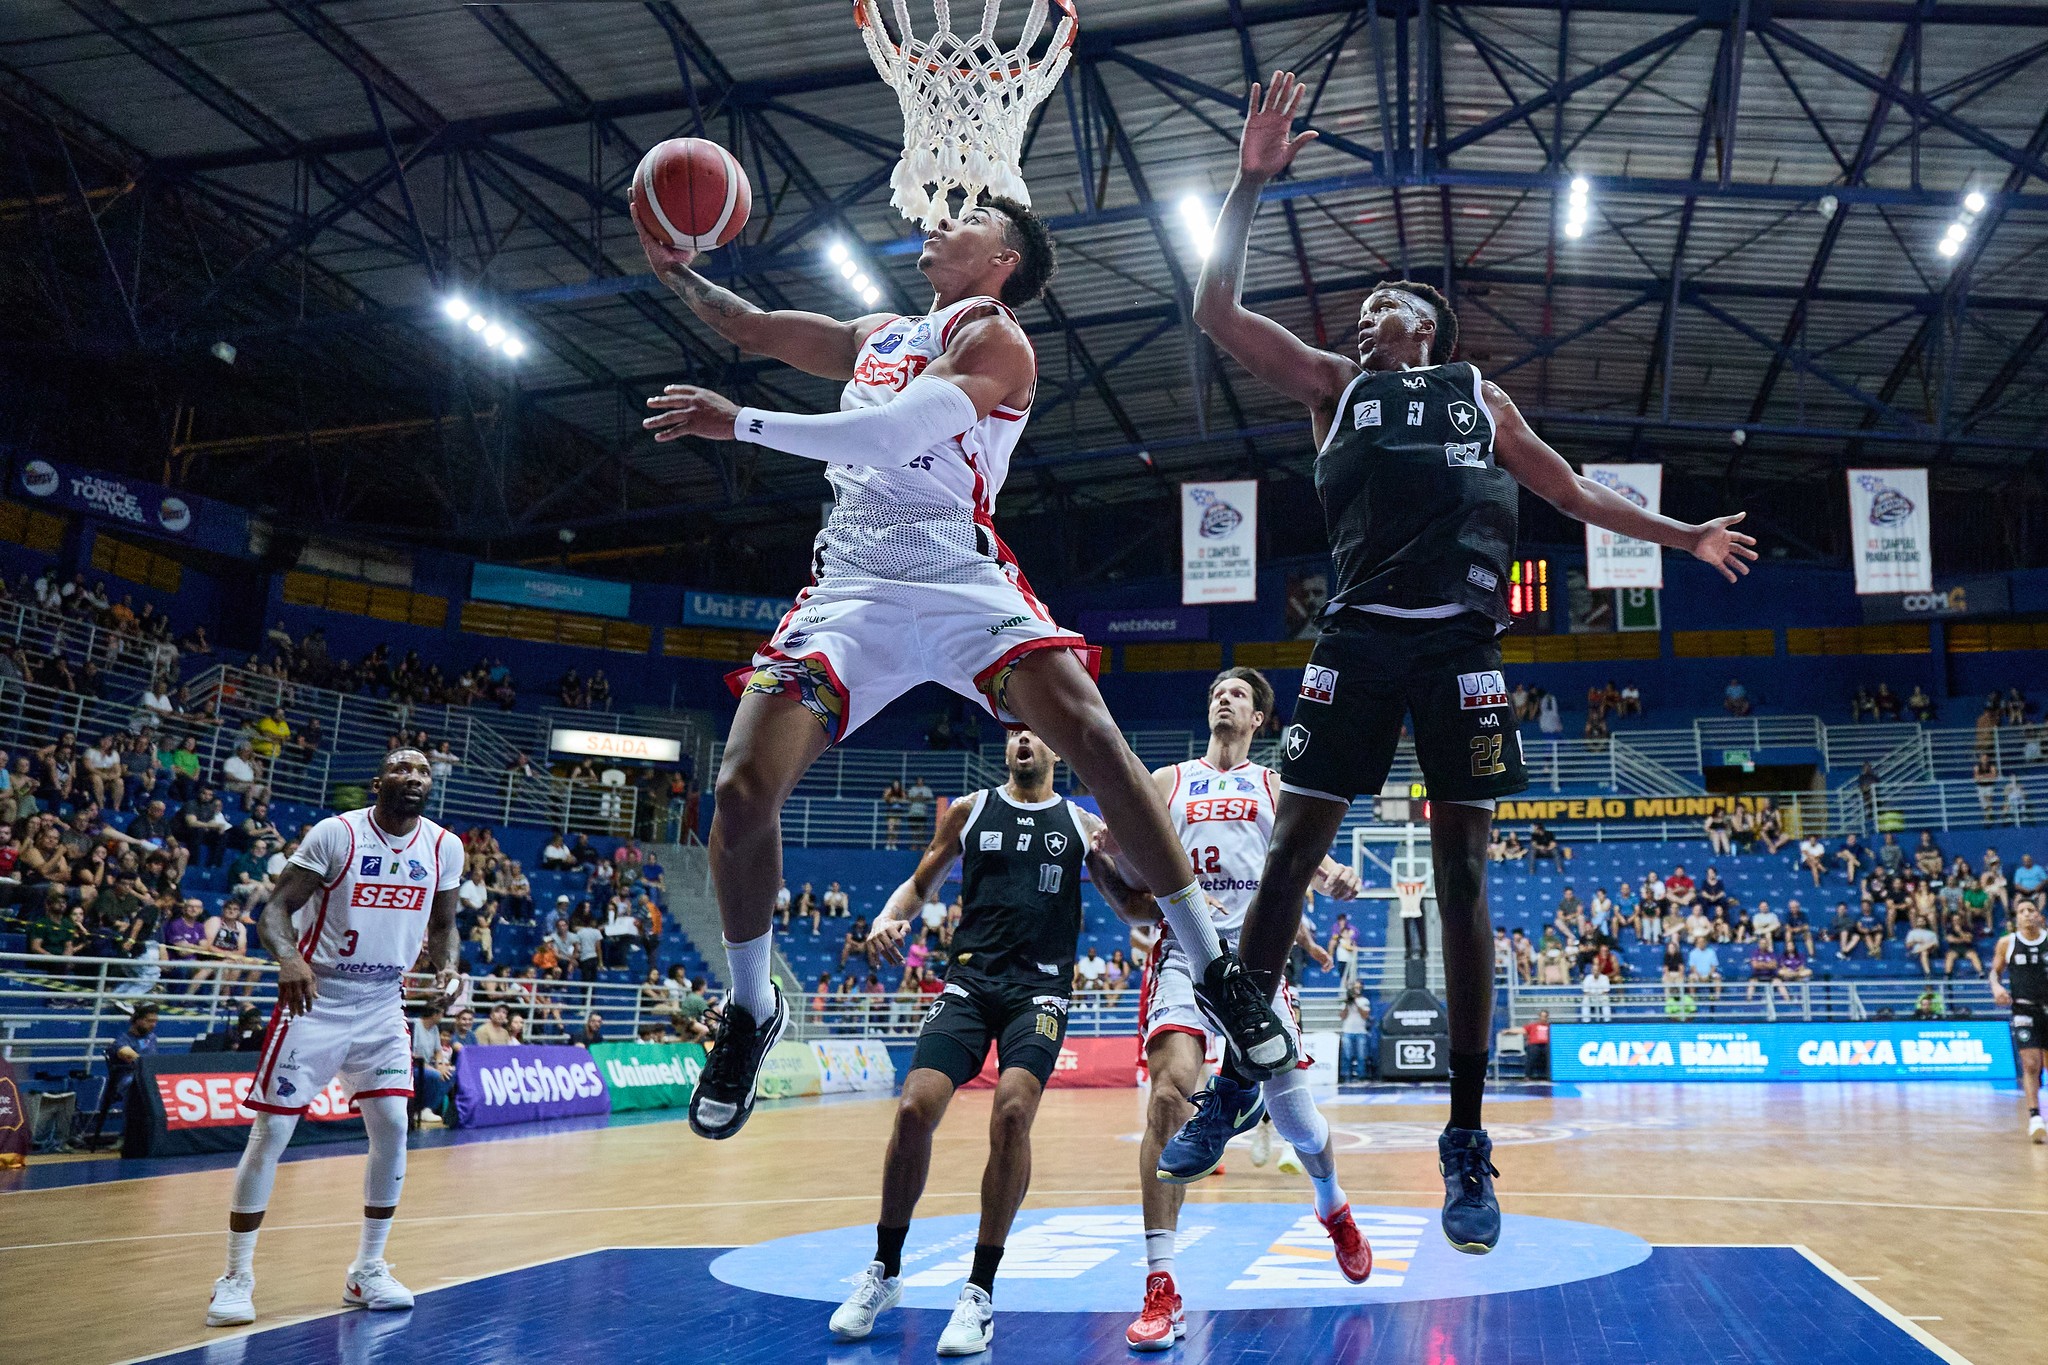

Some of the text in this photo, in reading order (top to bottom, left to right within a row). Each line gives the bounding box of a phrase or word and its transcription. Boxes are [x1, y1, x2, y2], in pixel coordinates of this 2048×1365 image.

[70, 479, 138, 508] TORCE
[1304, 689, 1322, 698] ET
[1470, 734, 1507, 777] 22
[1191, 799, 1254, 821] SESI
[1491, 797, 1626, 820] AMPEÃO
[1190, 846, 1221, 875] 12
[1038, 863, 1063, 894] 10
[358, 886, 421, 908] SESI
[338, 929, 359, 957] 3
[1035, 1014, 1058, 1041] 10
[1578, 1041, 1769, 1067] CAIXA BRASIL
[1798, 1039, 1993, 1066] CAIXA BRASIL
[480, 1057, 603, 1107] Netshoes
[606, 1056, 684, 1089] Unimed
[174, 1077, 259, 1123] SES
[308, 1078, 350, 1117] SE
